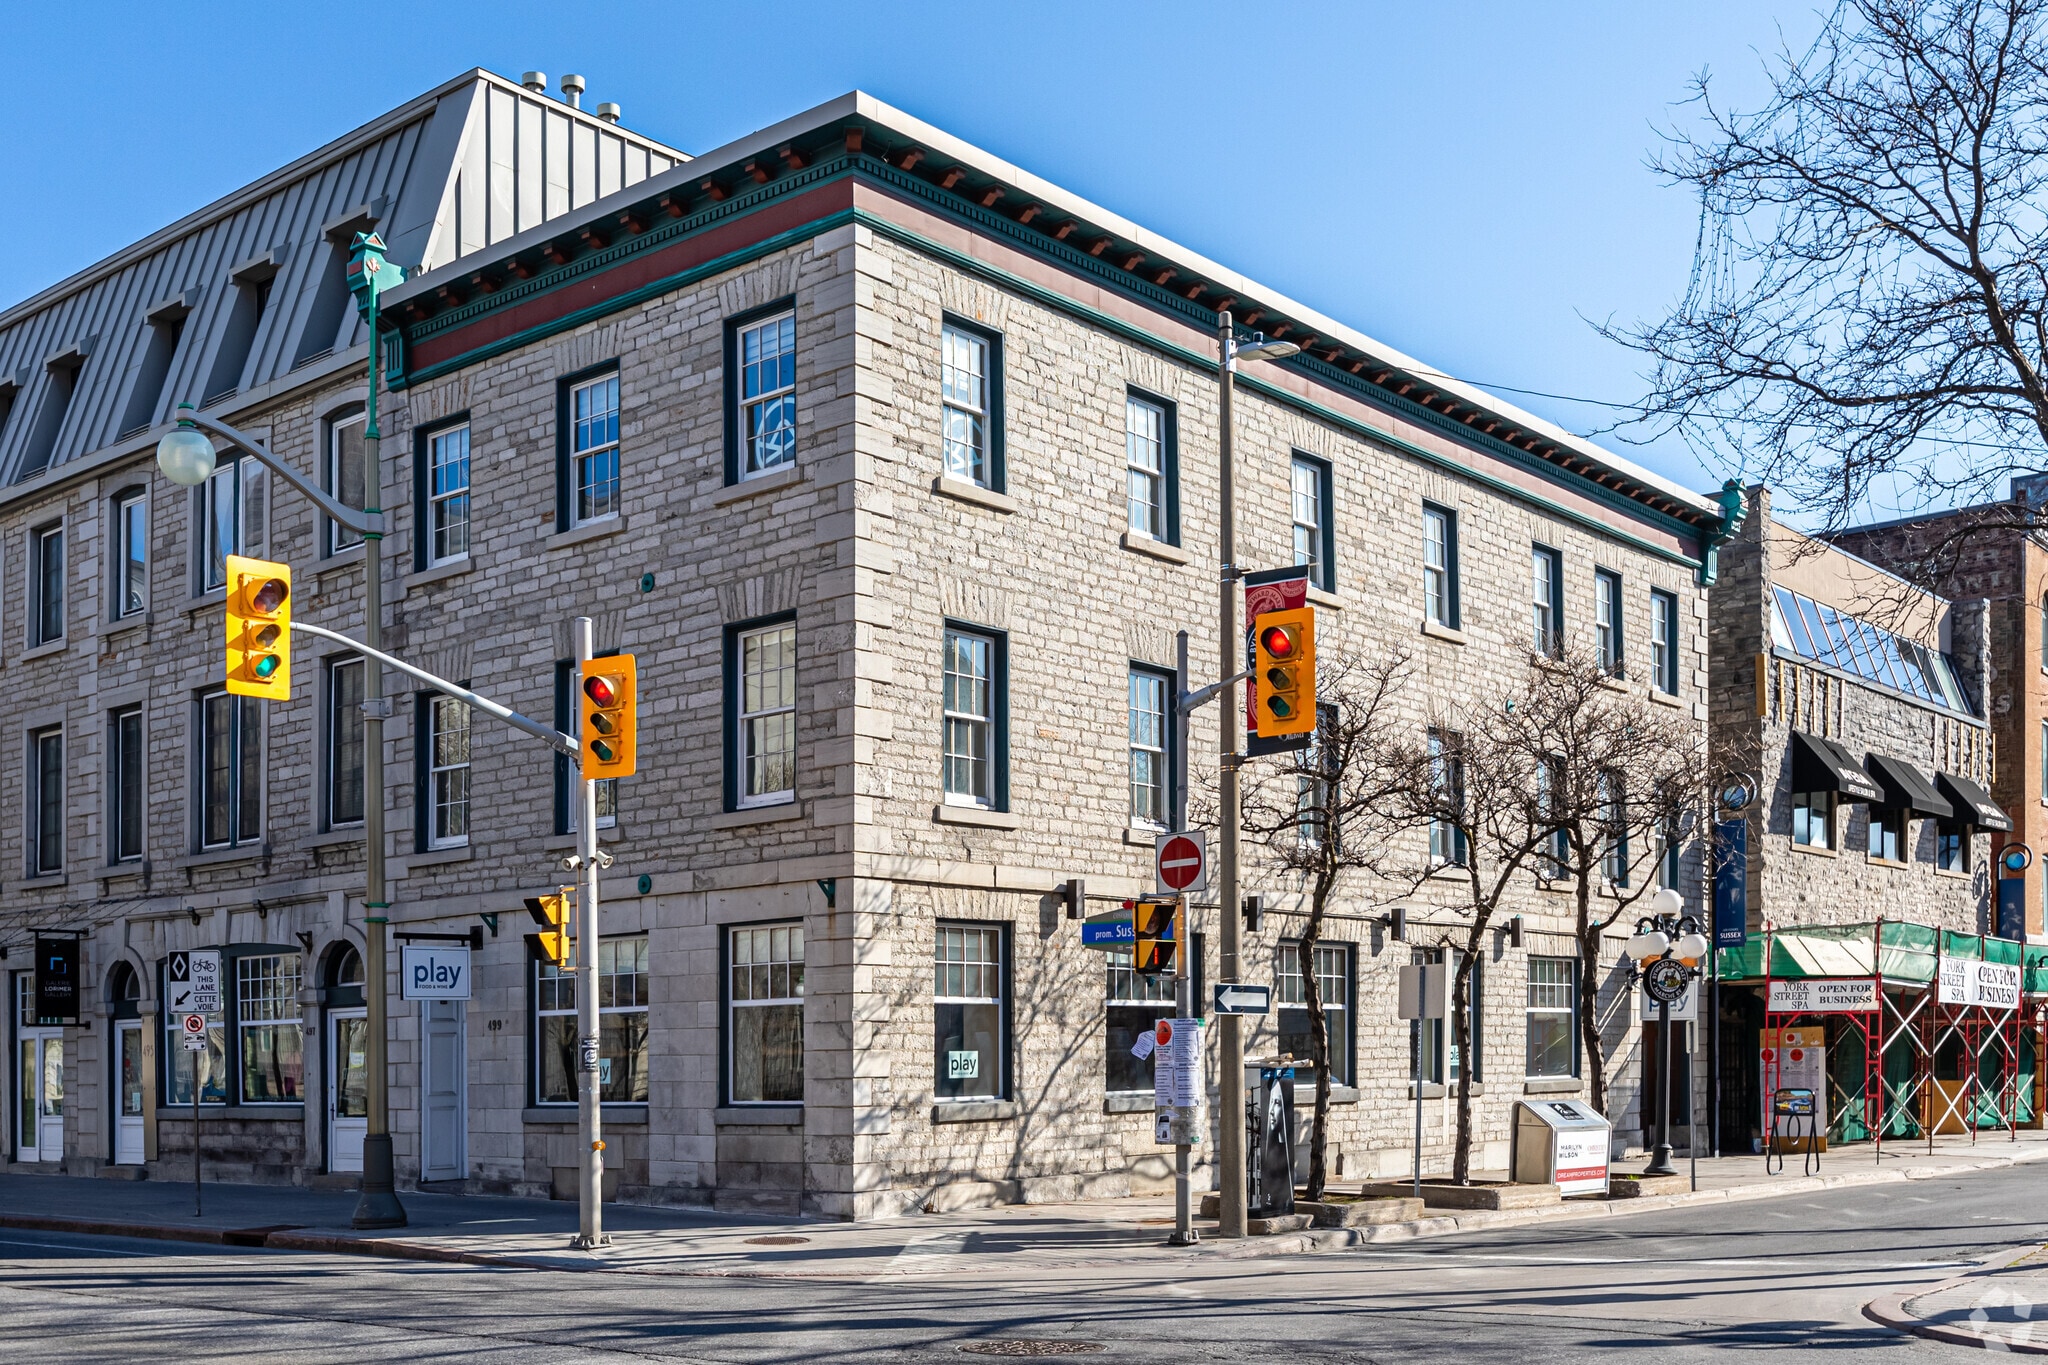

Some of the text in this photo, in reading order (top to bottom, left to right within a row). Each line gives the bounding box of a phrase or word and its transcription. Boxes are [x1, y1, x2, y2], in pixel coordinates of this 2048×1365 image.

[1095, 924, 1135, 940] prom. Suss
[1652, 962, 1686, 980] BYWARD MARKET
[1945, 959, 1966, 974] YORK
[414, 956, 462, 989] play
[195, 984, 215, 992] LANE
[1784, 982, 1810, 992] YORK
[1818, 984, 1872, 993] OPEN FOR
[1774, 992, 1810, 1001] STREET
[1819, 995, 1872, 1004] BUSINESS
[1951, 988, 1966, 1002] SPA
[1978, 985, 2015, 1004] BSINESS
[1792, 1000, 1809, 1010] SPA
[306, 1026, 316, 1036] 497
[487, 1020, 502, 1031] 499
[142, 1045, 154, 1057] 495
[951, 1052, 977, 1076] play
